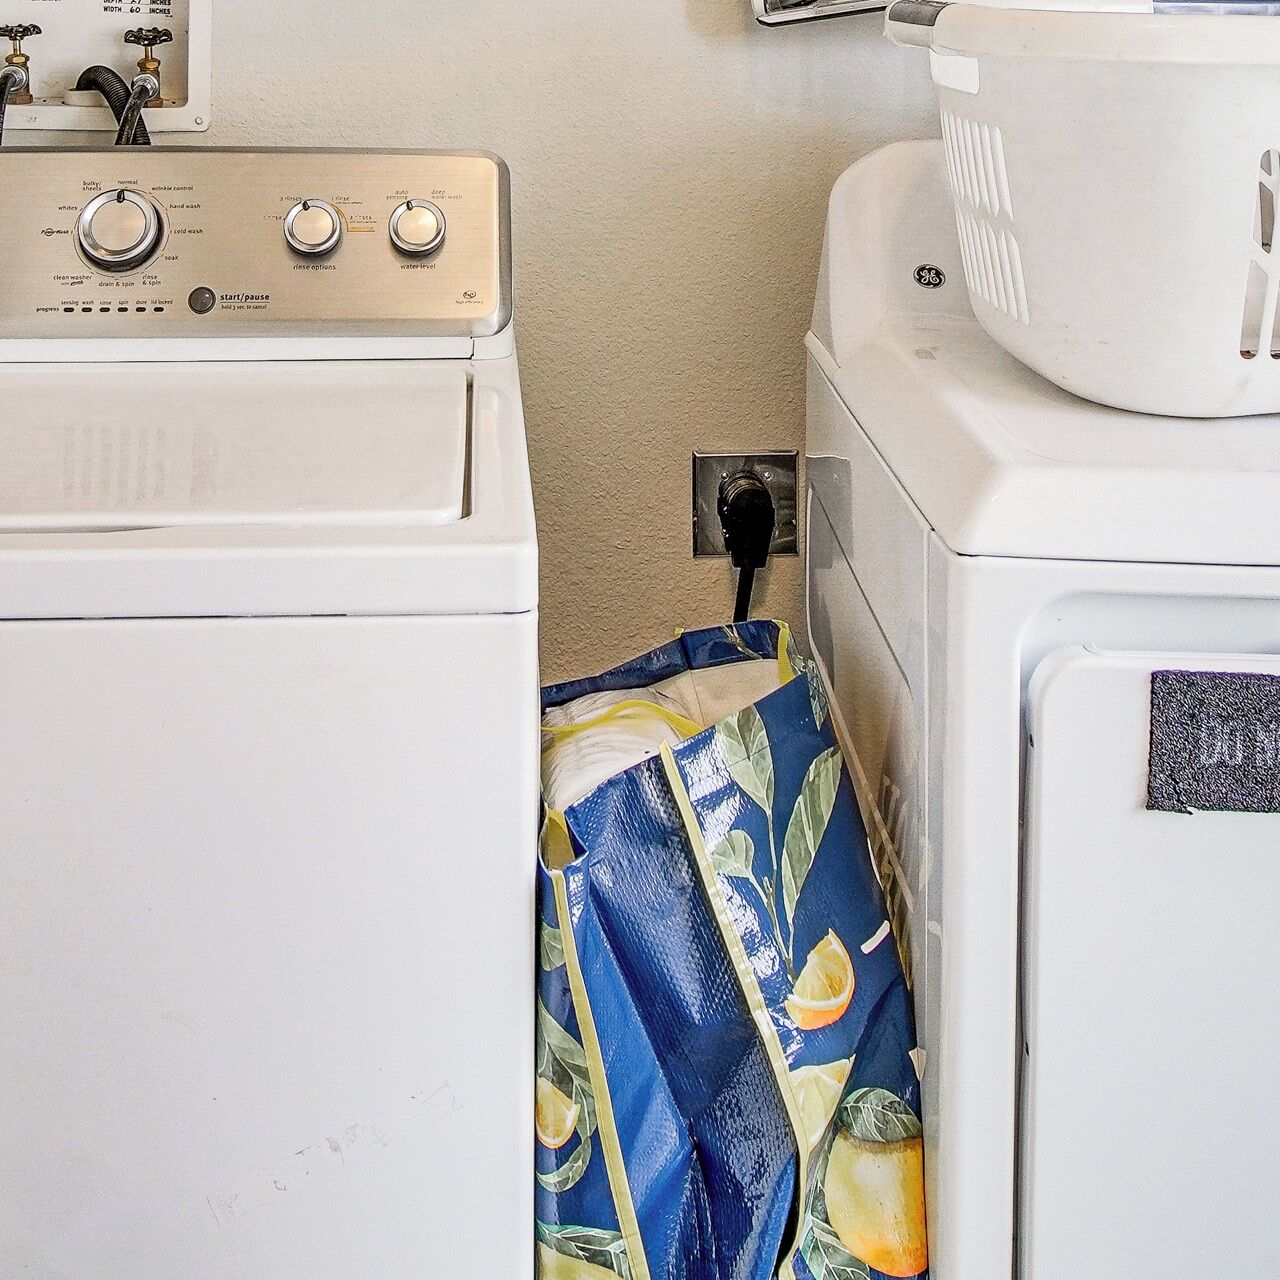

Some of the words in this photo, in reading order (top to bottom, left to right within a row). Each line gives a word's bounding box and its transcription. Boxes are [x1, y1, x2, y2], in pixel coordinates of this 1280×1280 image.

[311, 263, 336, 272] options
[220, 293, 270, 302] start/pause
[1199, 724, 1244, 766] DO
